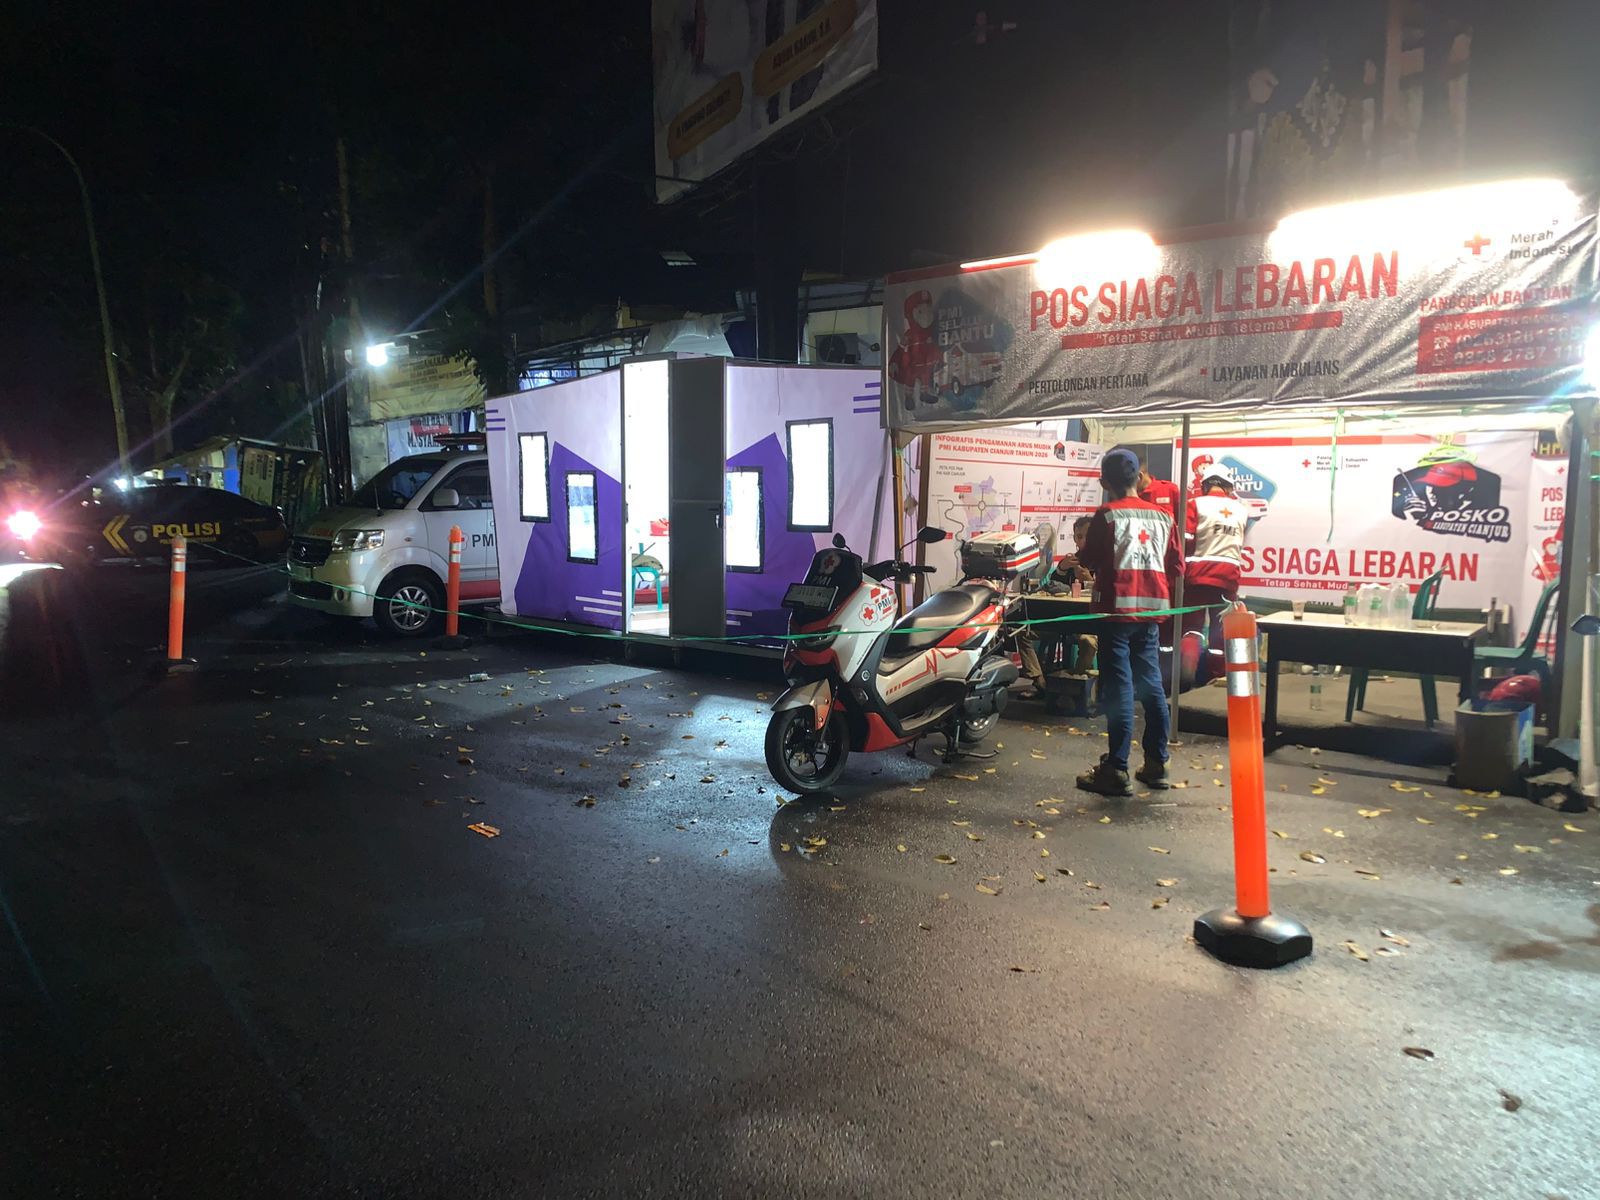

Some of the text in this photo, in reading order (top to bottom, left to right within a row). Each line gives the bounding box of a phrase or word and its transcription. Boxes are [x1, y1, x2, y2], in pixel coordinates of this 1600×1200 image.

[1510, 230, 1554, 244] Merah
[1509, 244, 1576, 260] Indonesi
[1030, 250, 1399, 331] POS SIAGA LEBARAN
[938, 323, 994, 346] BANTU
[1213, 359, 1340, 382] LAYANAN AMBULANS
[1028, 372, 1149, 394] PERTOLONGAN PERTAMA
[935, 434, 974, 444] INFOGRAFIS
[975, 438, 1016, 448] PENGAMANAN
[952, 445, 989, 454] KABUPATEN
[1234, 480, 1263, 492] NTU
[1541, 486, 1564, 502] POS
[1430, 508, 1506, 523] POSKO
[151, 521, 222, 538] POLISI
[1432, 521, 1468, 533] KABUPATEN
[1467, 523, 1509, 539] CIANJUR
[471, 533, 494, 548] PM
[1133, 551, 1152, 565] PM
[1261, 546, 1340, 576] SIAGA
[1348, 549, 1479, 582] LEBARAN
[1259, 578, 1349, 590] "Tetap Sehat, Mud
[877, 598, 891, 611] PMI
